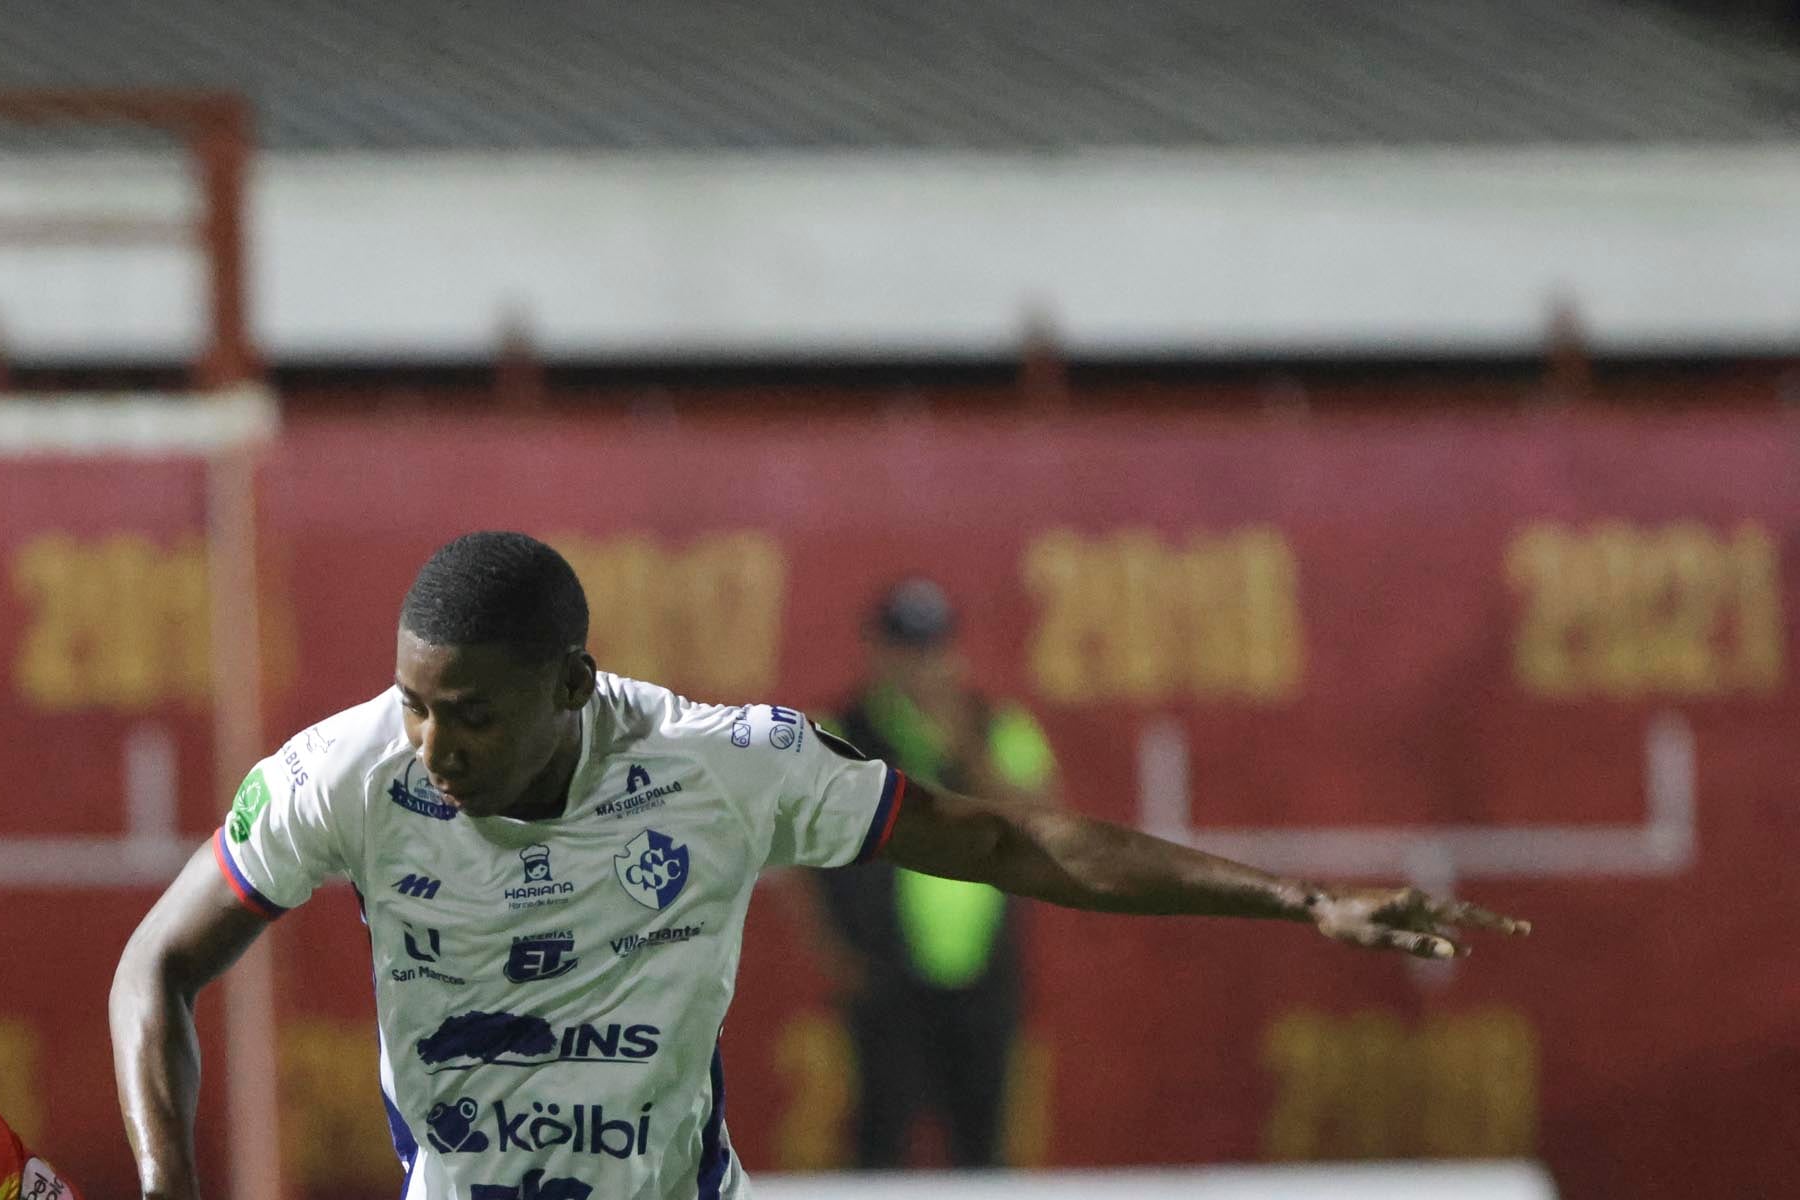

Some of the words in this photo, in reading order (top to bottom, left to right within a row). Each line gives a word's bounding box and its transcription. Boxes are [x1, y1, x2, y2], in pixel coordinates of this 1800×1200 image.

[504, 881, 575, 900] HARIANA
[391, 968, 416, 982] San
[418, 966, 466, 985] Marcos
[559, 1022, 661, 1062] INS
[493, 1100, 654, 1160] kölbi
